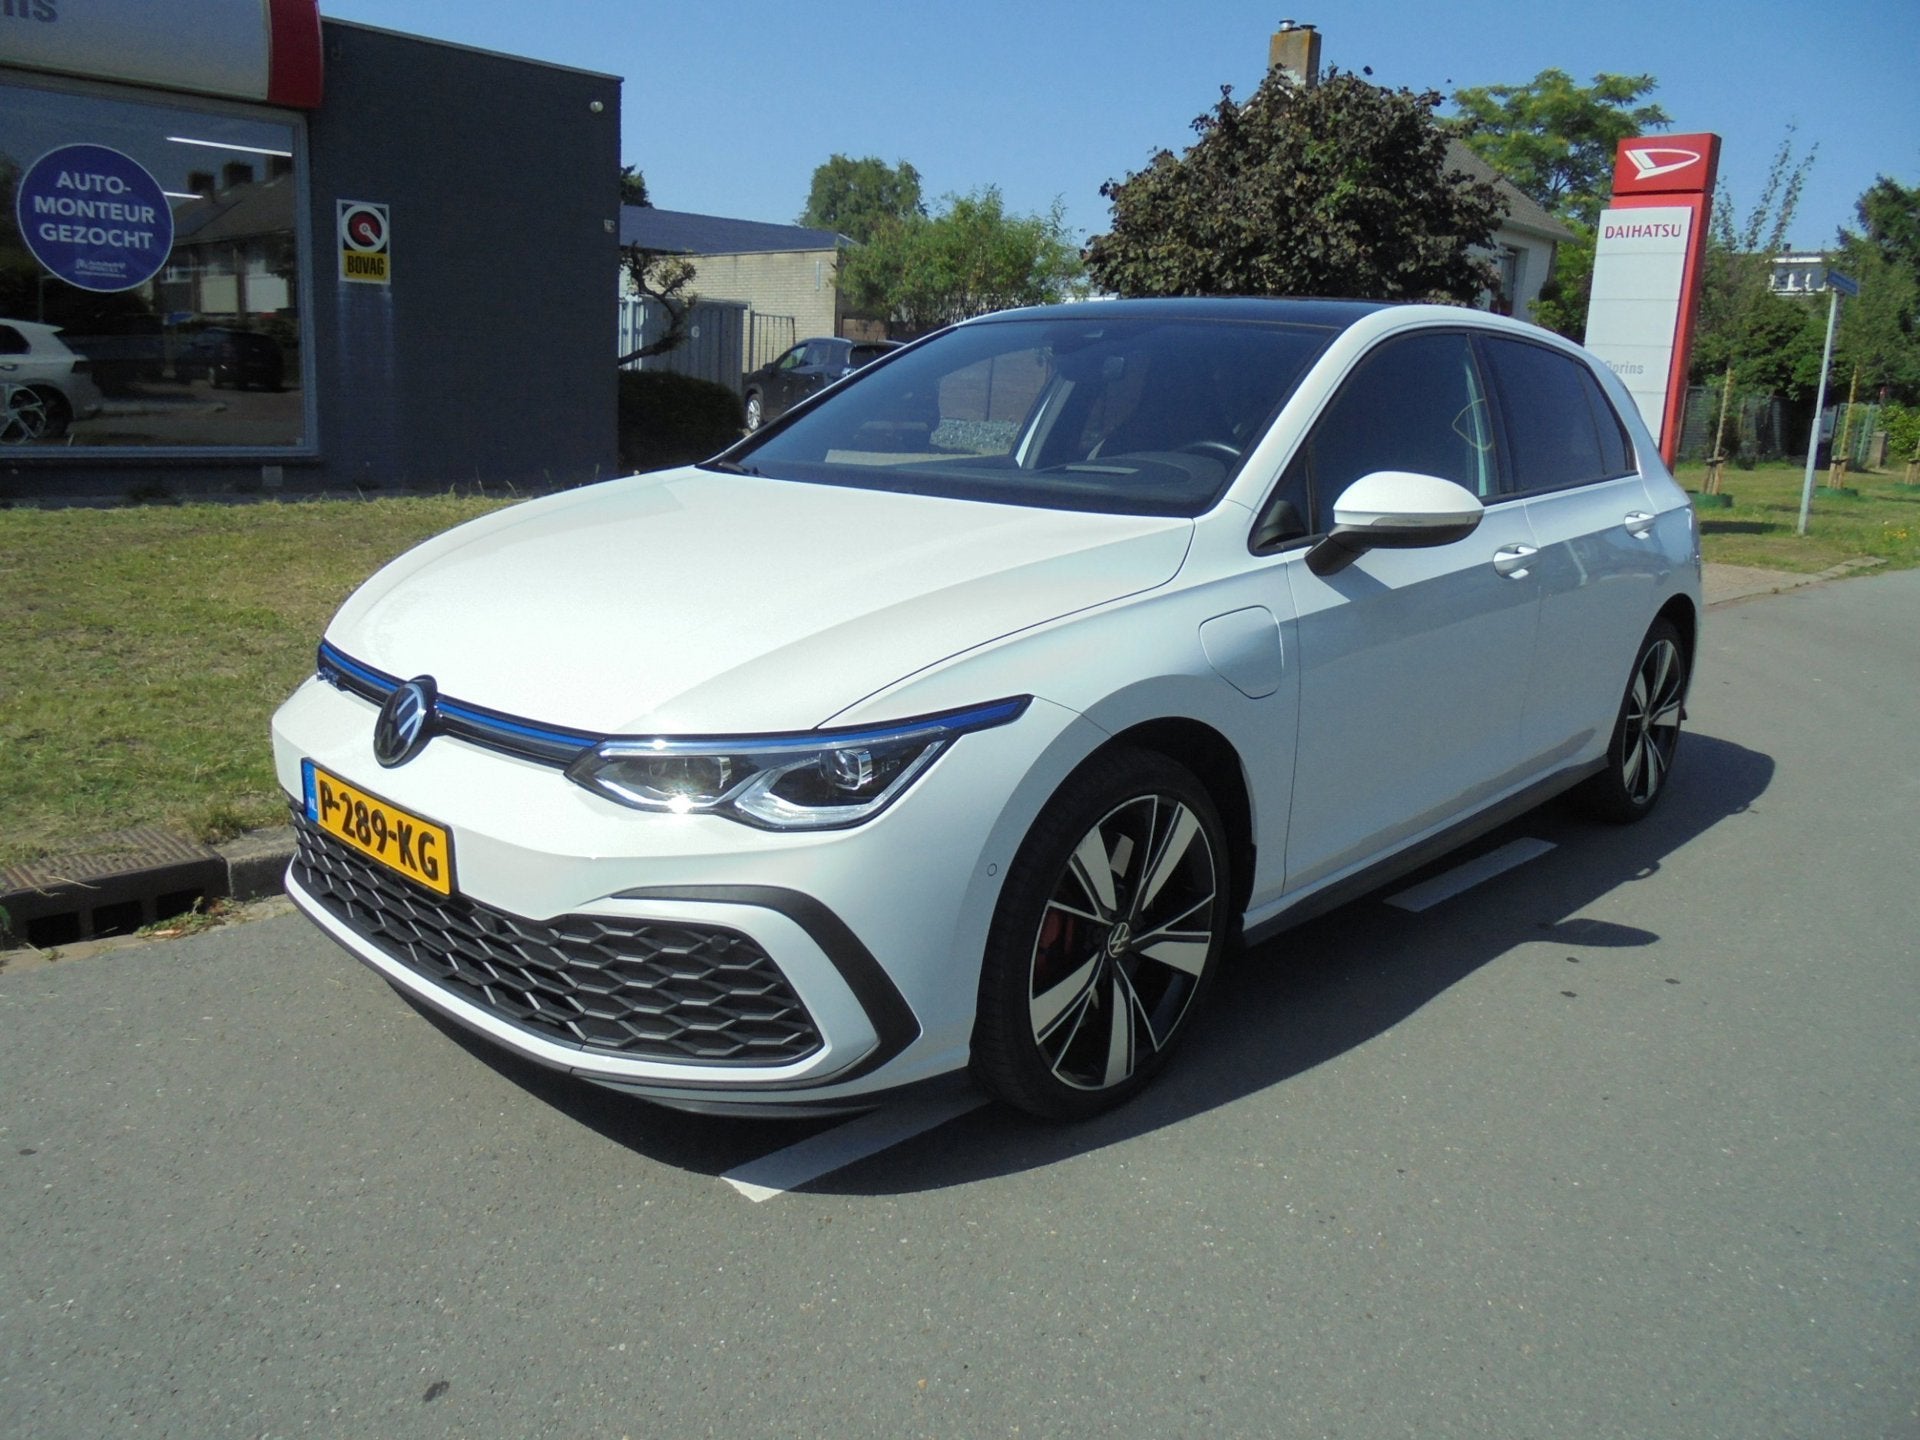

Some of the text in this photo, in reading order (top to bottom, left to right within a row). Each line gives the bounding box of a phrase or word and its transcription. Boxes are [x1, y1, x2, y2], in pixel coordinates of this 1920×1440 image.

[56, 171, 131, 195] AUTO-
[34, 195, 155, 224] MONTEUR
[39, 223, 153, 249] GEZOCHT
[1605, 223, 1682, 239] DAIHATSU
[347, 255, 385, 275] BOVAG
[319, 779, 439, 882] P-289-KG
